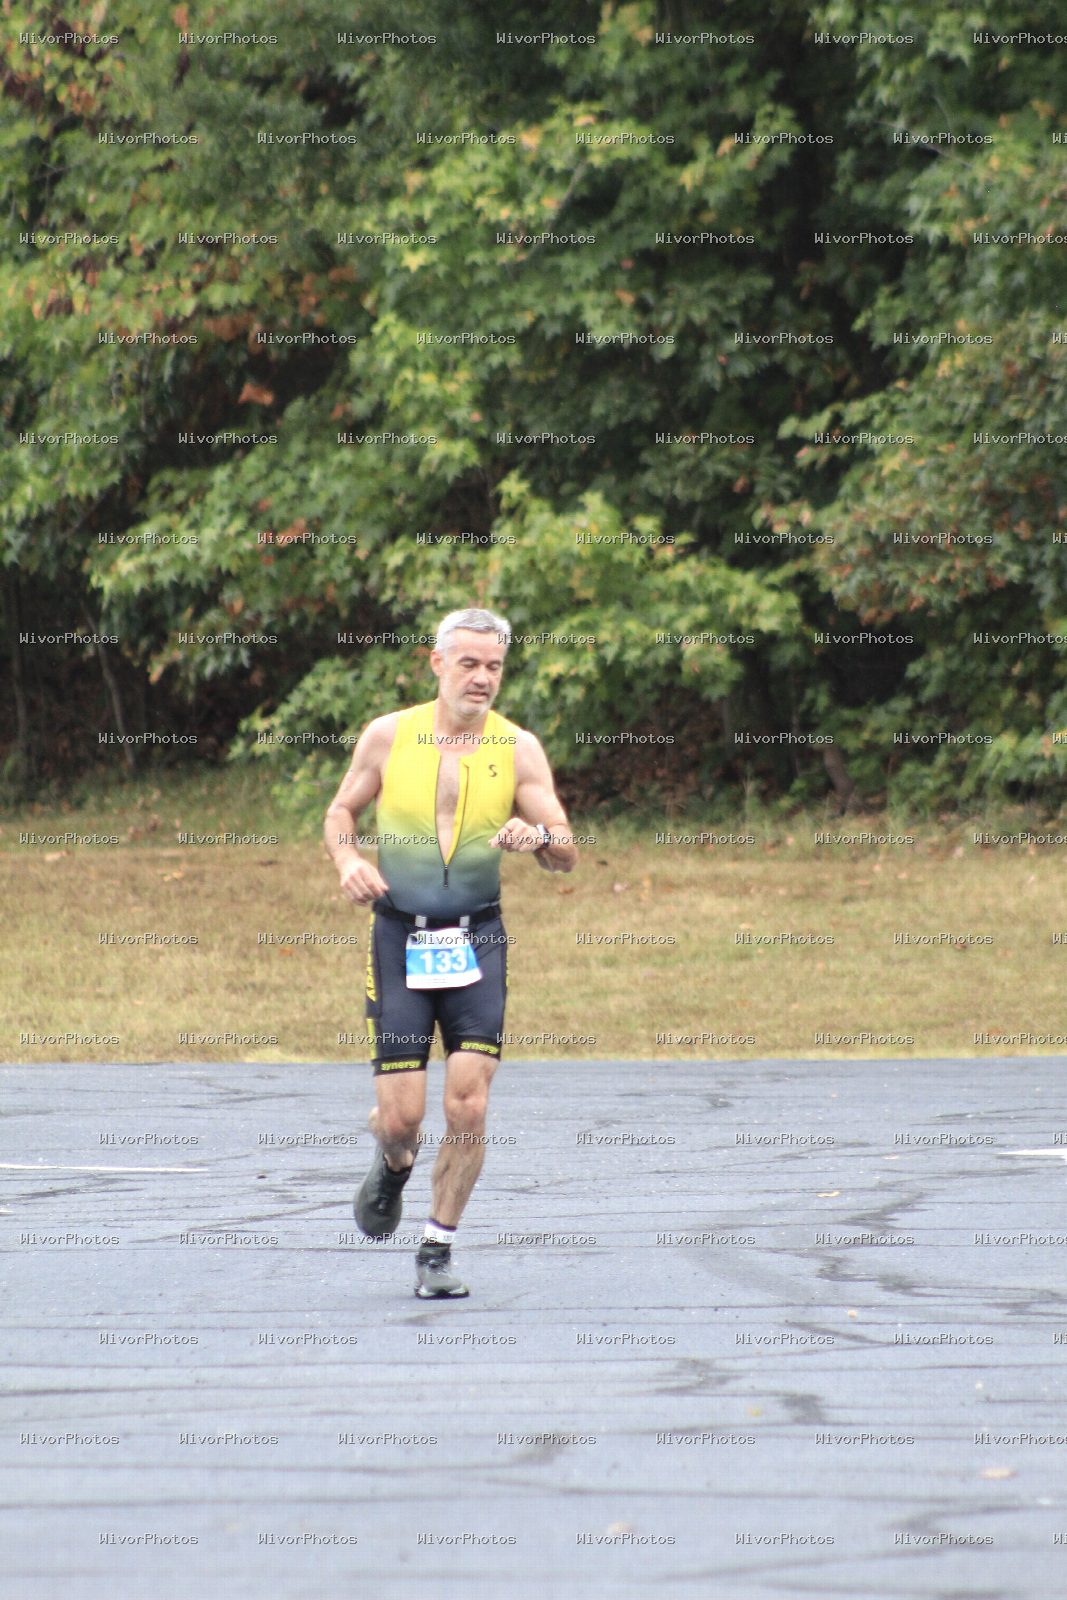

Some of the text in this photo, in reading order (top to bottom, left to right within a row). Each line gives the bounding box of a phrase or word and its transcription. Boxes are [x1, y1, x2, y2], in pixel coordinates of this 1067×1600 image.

[419, 948, 468, 975] 133
[460, 1041, 499, 1055] synergy
[381, 1060, 421, 1071] synergy
